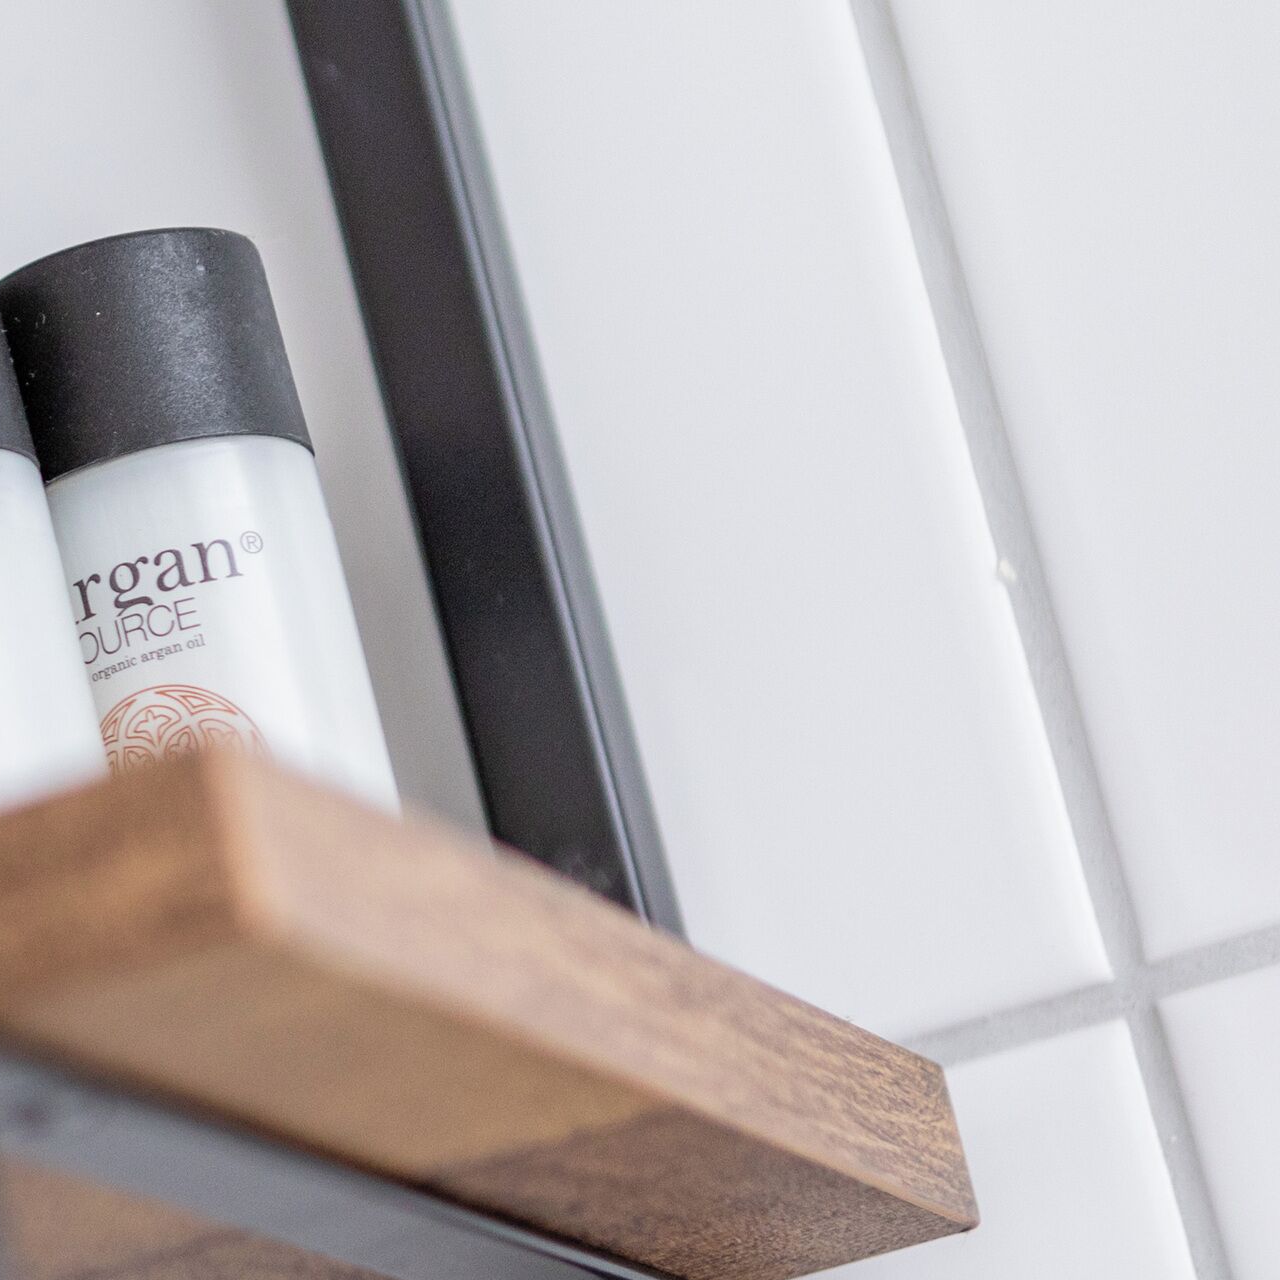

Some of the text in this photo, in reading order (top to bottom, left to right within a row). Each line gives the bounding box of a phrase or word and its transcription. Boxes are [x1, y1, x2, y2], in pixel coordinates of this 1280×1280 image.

[74, 530, 264, 624] rgan®
[91, 633, 207, 682] organic argan oil
